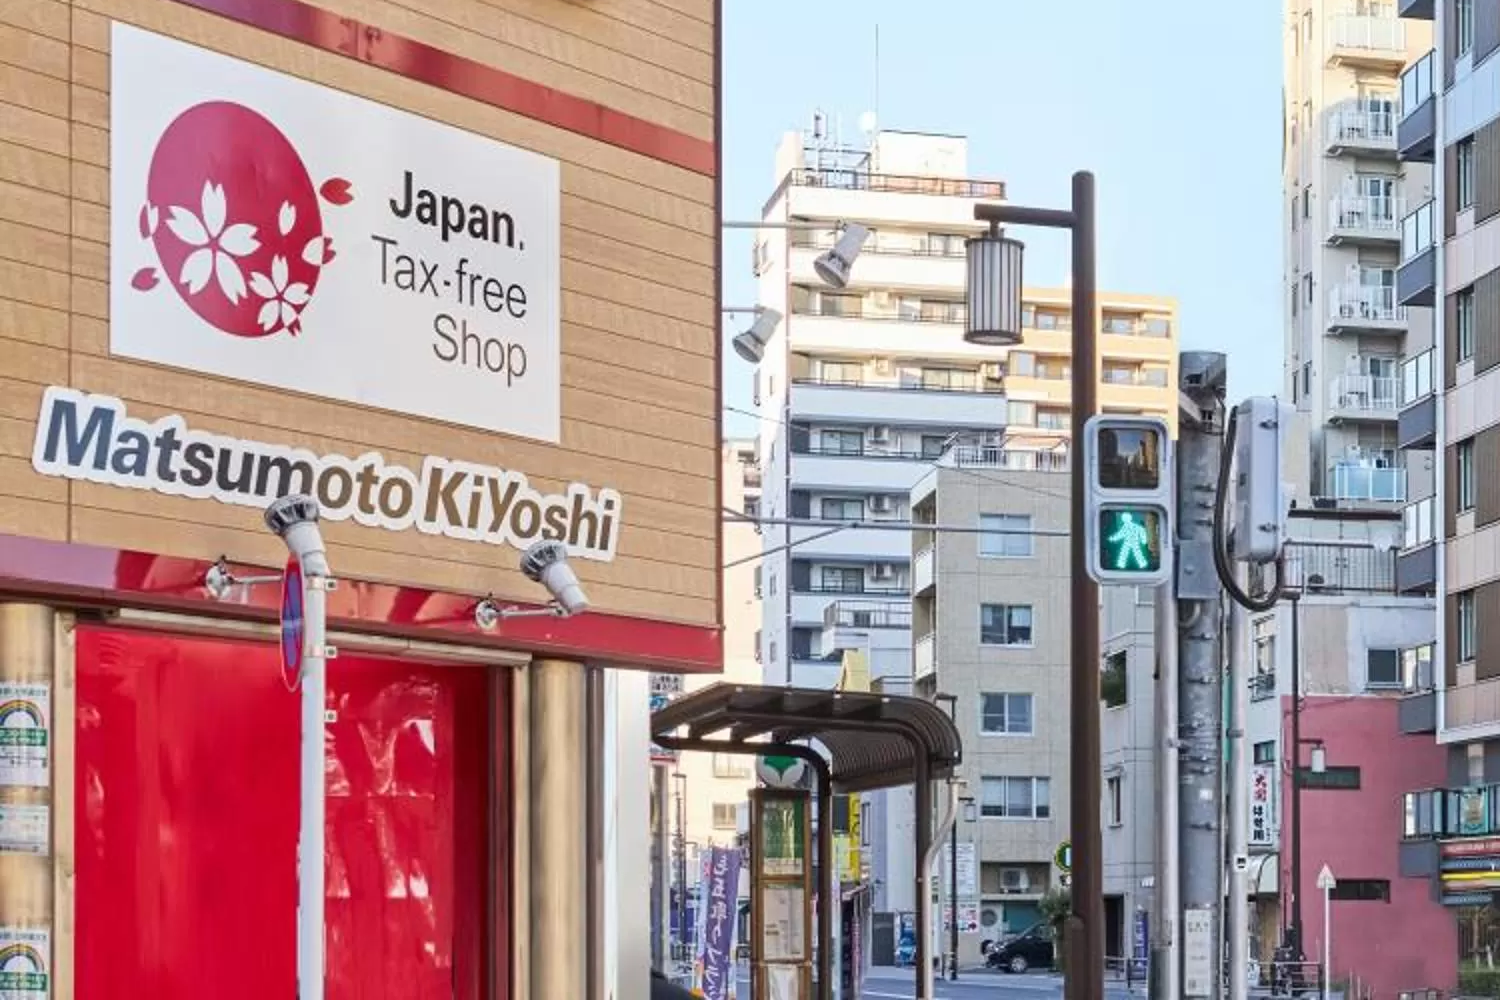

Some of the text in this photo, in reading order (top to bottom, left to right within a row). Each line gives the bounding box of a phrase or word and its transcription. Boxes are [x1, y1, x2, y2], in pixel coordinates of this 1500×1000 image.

[389, 170, 525, 252] Japan.
[371, 236, 528, 319] Tax-free
[432, 312, 528, 388] Shop
[43, 398, 413, 520] Matsumoto
